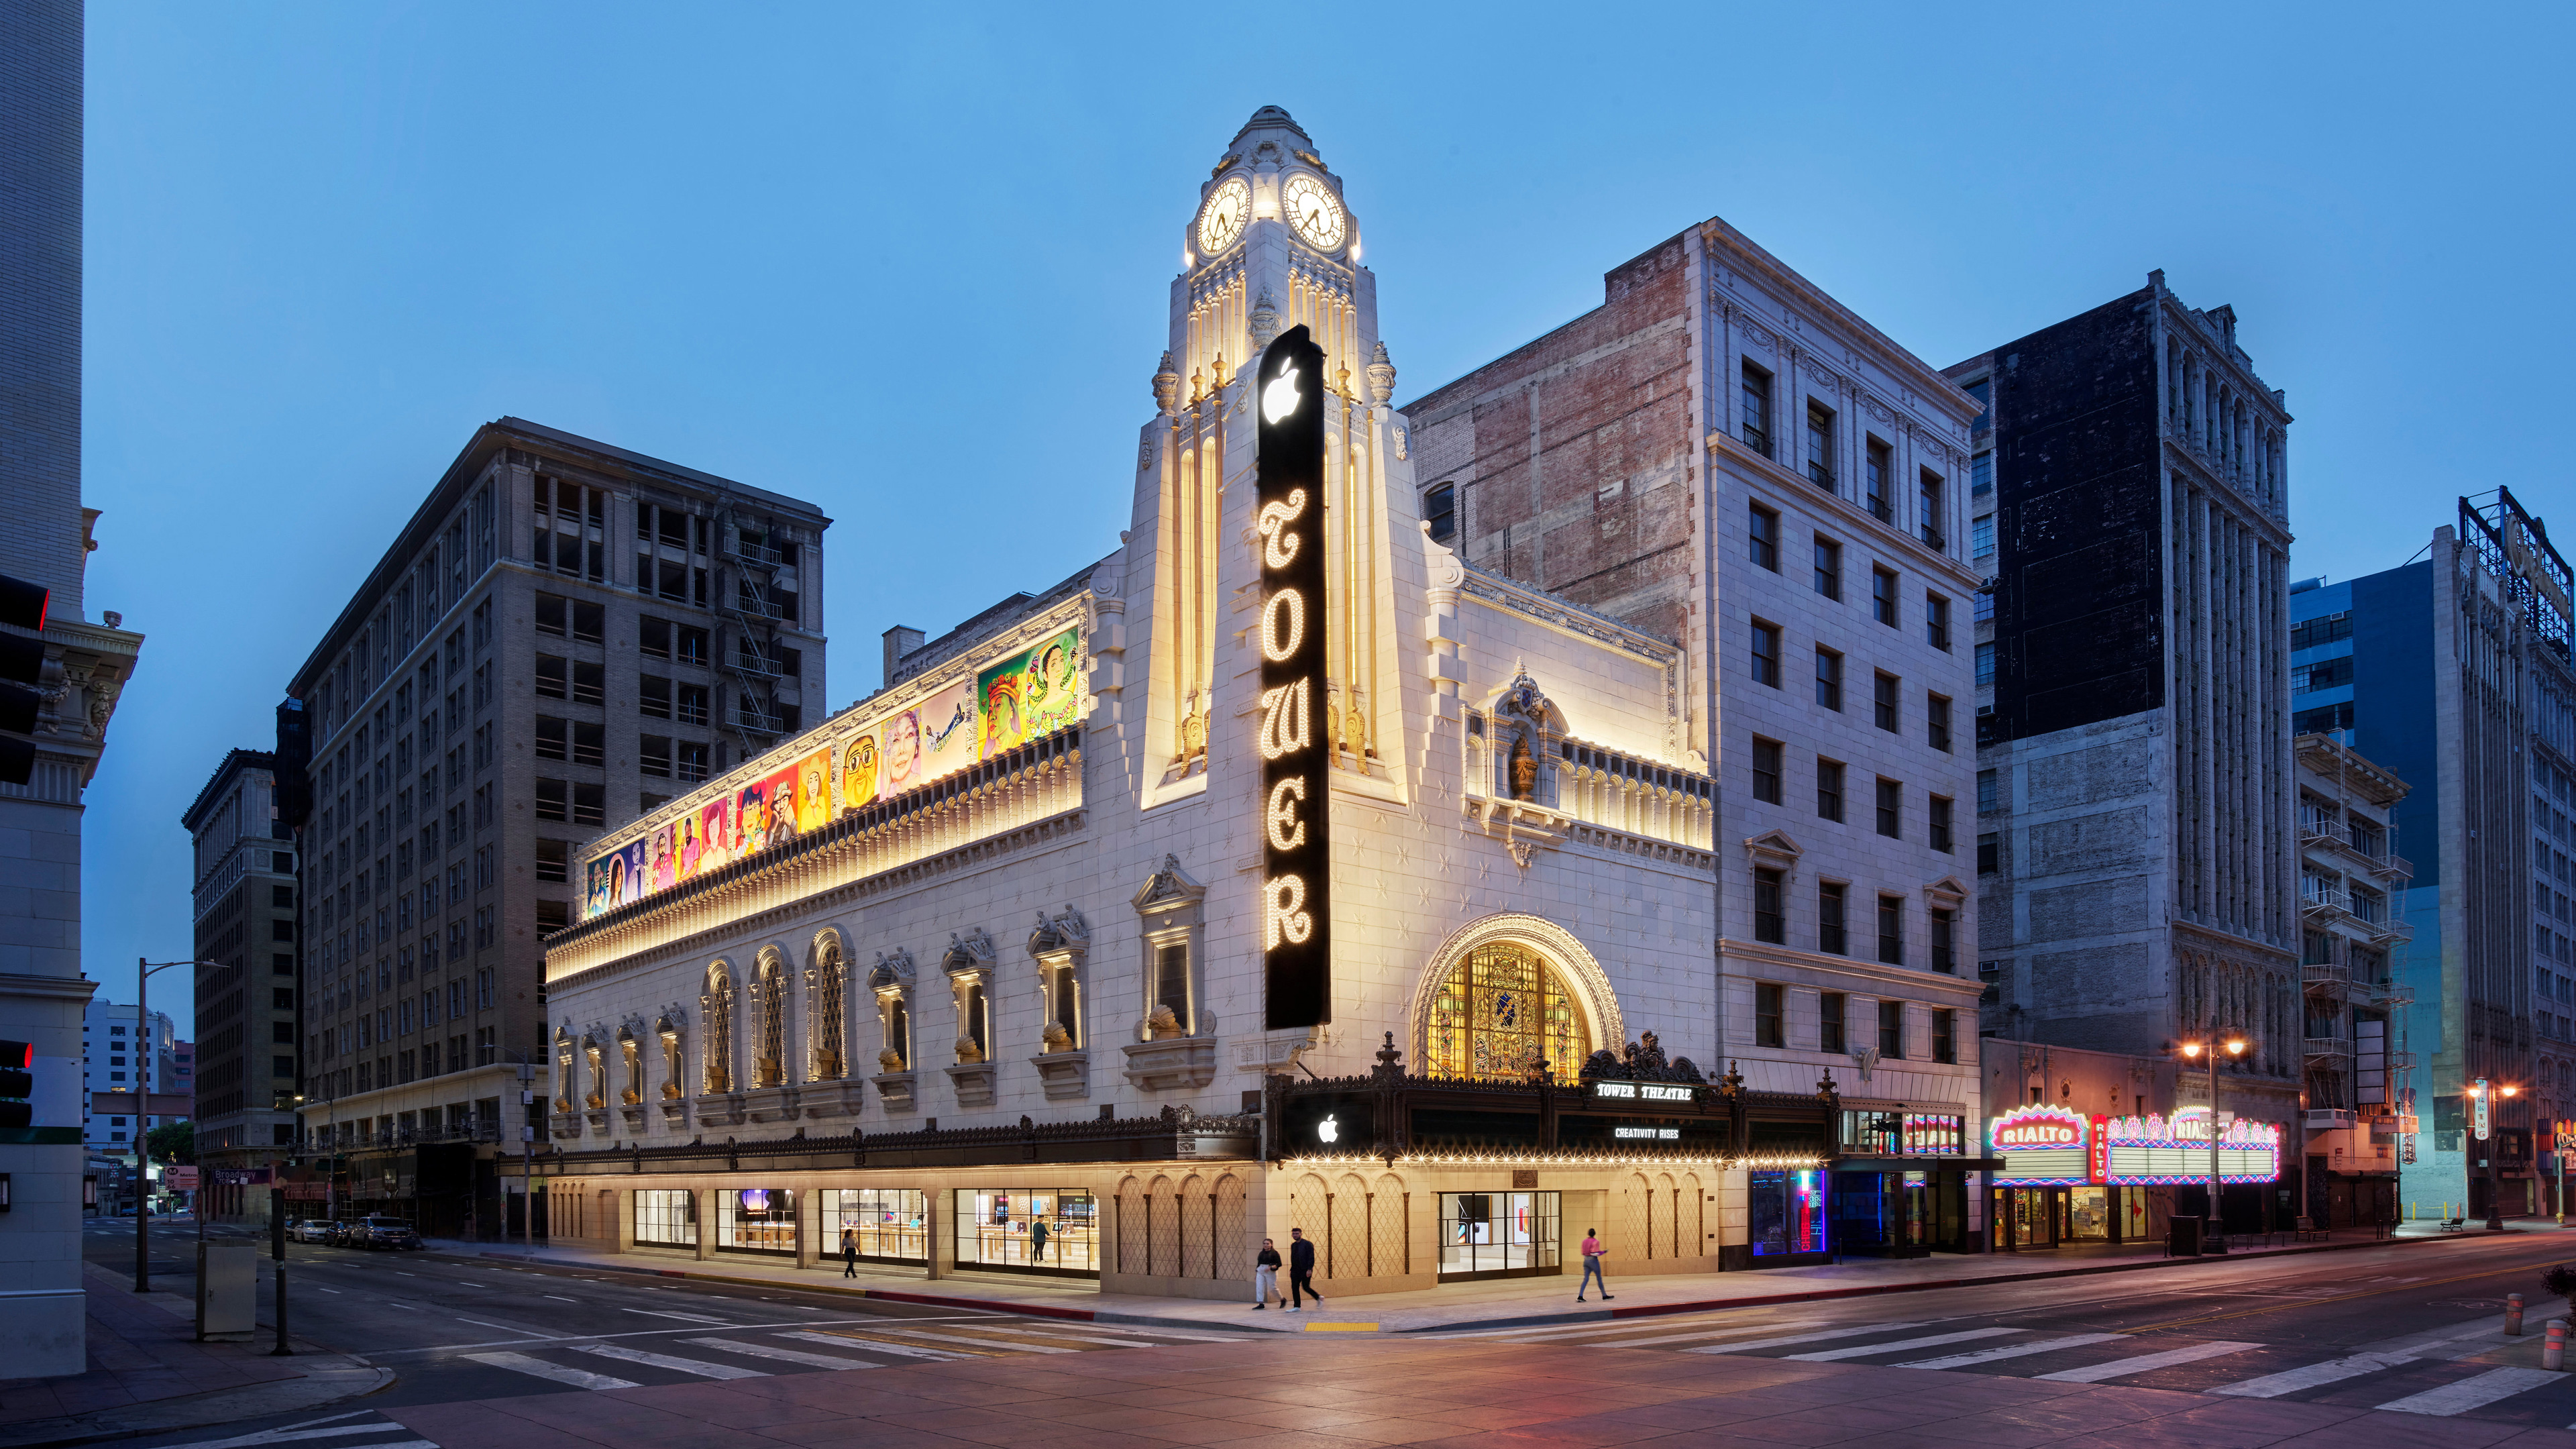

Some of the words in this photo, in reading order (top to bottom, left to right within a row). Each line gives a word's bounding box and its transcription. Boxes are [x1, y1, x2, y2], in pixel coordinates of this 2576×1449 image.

[1258, 487, 1311, 952] TOWER
[1597, 1083, 1635, 1097] TOWER
[1641, 1086, 1692, 1101] THEATRE
[1615, 1128, 1657, 1138] CREATIVITY
[1659, 1129, 1679, 1139] RISES
[2004, 1126, 2072, 1142] RIALTO
[2176, 1121, 2224, 1140] RIAL
[2096, 1124, 2105, 1177] RIALTO
[215, 1170, 256, 1180] Broadway
